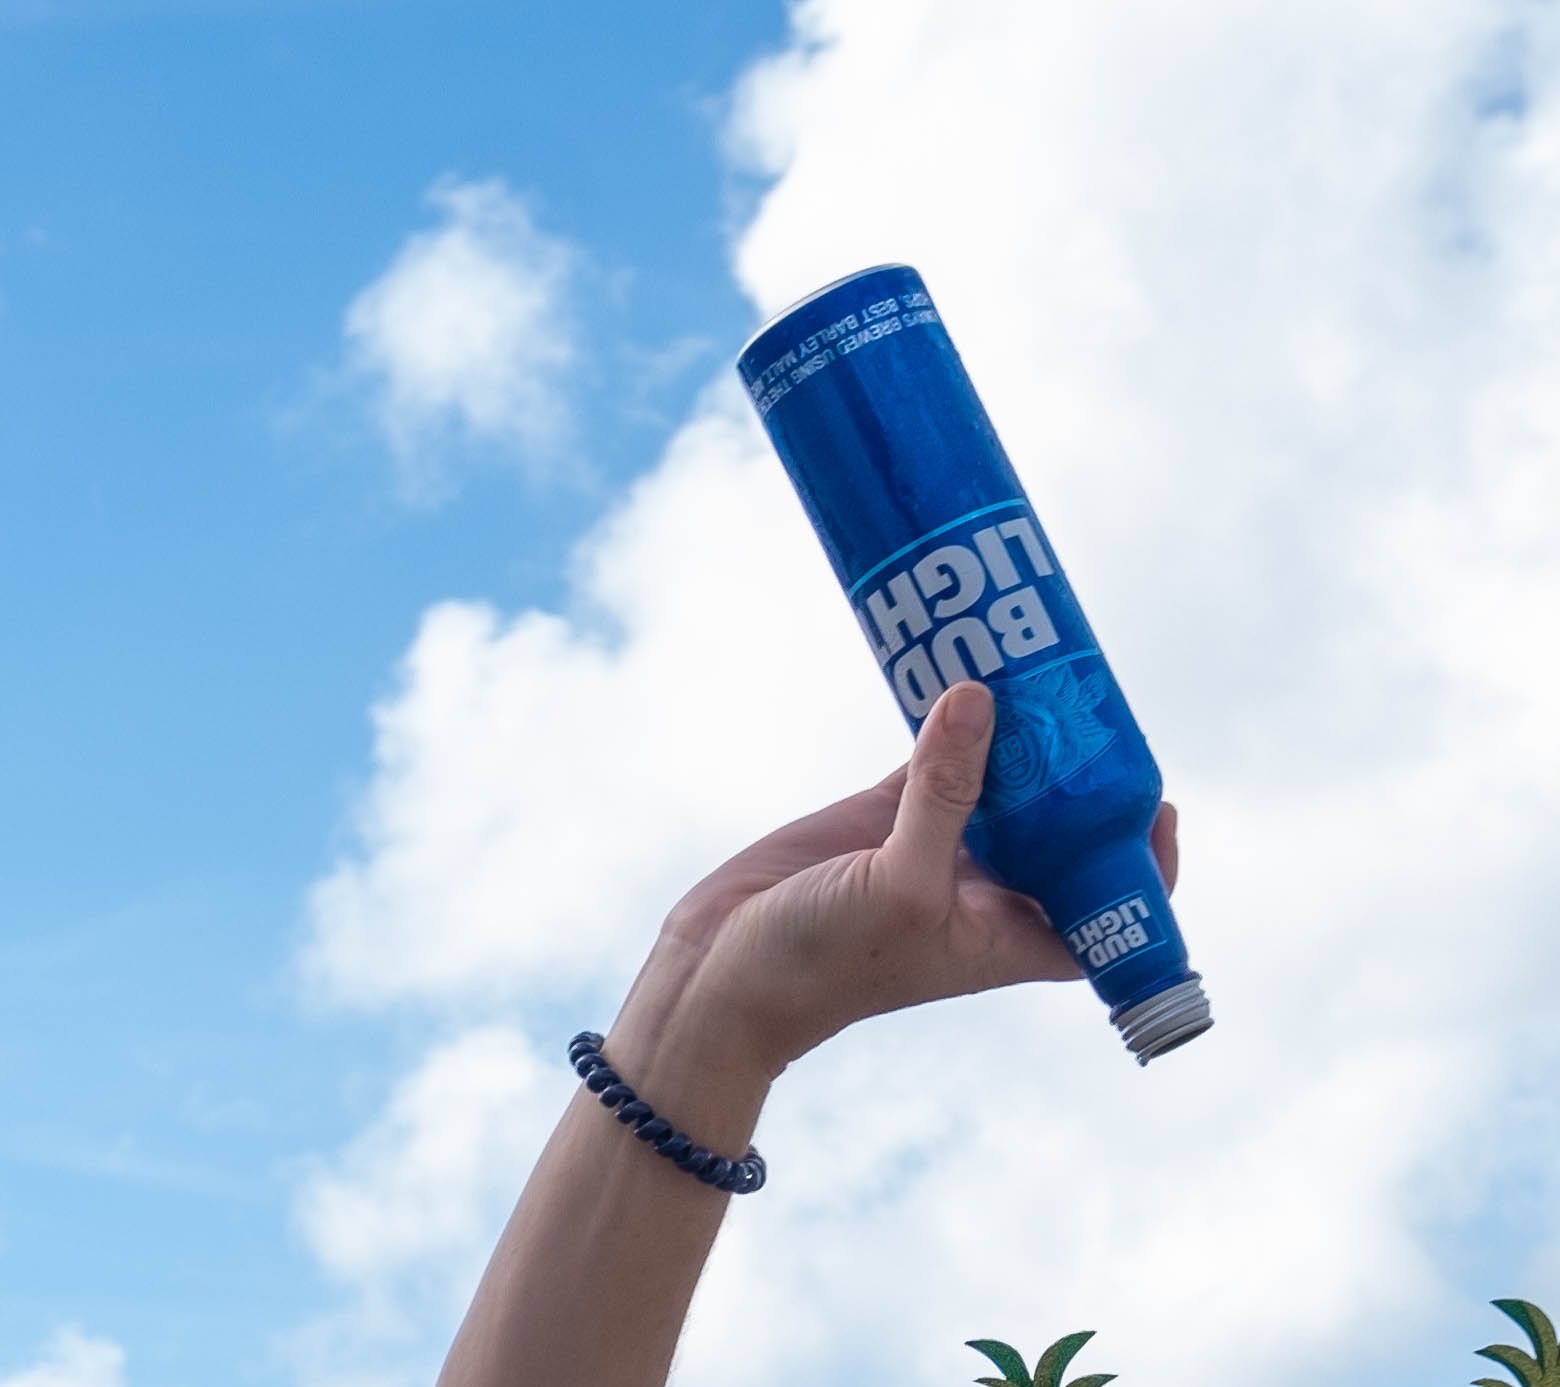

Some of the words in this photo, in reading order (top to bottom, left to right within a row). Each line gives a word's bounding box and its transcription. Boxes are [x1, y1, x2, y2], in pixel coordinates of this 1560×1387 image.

[861, 298, 899, 323] BEST
[799, 314, 859, 359] BARLEY
[836, 316, 903, 356] BREWED
[893, 585, 1061, 720] BUD
[1067, 896, 1151, 956] LIGHT
[1087, 921, 1149, 969] BUD
